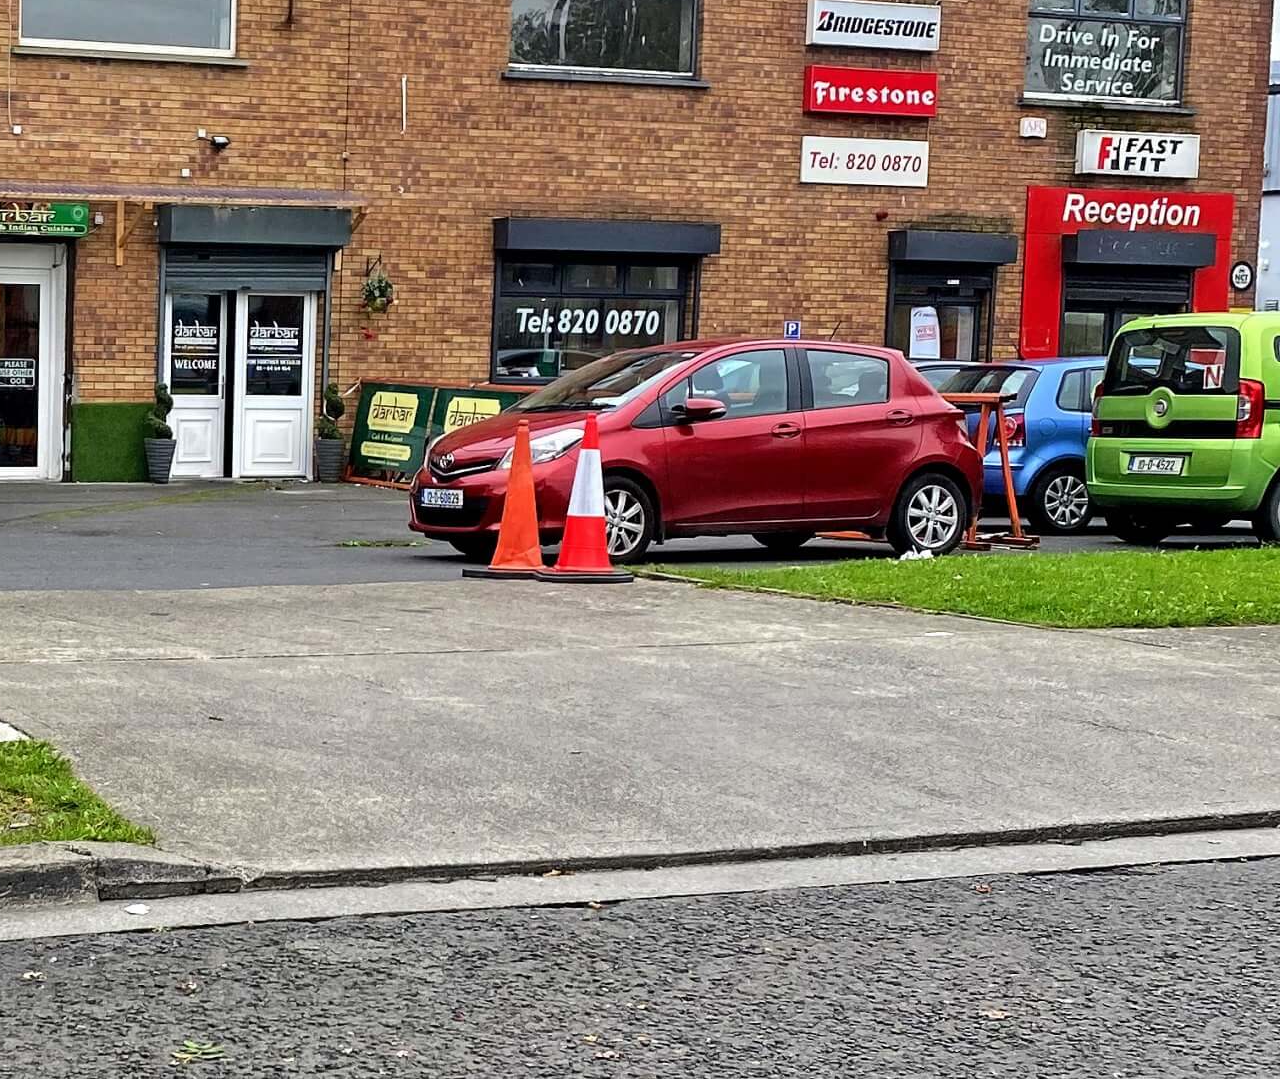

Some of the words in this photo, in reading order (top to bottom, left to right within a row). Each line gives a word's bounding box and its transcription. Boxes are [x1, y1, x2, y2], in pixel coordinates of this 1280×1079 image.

[816, 11, 937, 38] BRIDGESTONE
[1039, 24, 1093, 46] Drive
[1101, 28, 1119, 47] In
[1127, 30, 1160, 49] For
[1044, 48, 1152, 72] Immediate
[814, 81, 935, 105] Firestone
[1061, 73, 1134, 94] Service
[1126, 138, 1183, 154] FAST
[809, 152, 840, 169] Tel:
[846, 153, 876, 171] 820
[882, 155, 921, 172] 0870
[1124, 157, 1165, 172] FIT
[1063, 193, 1200, 231] Reception
[175, 319, 217, 337] darbar
[250, 321, 299, 338] darbar
[516, 308, 553, 333] Tel:
[558, 309, 599, 334] 820
[605, 310, 659, 335] 0870
[788, 323, 797, 336] P
[175, 360, 217, 369] WELCOME
[1206, 365, 1220, 386] N
[372, 394, 413, 422] darbar
[449, 401, 494, 426] darba
